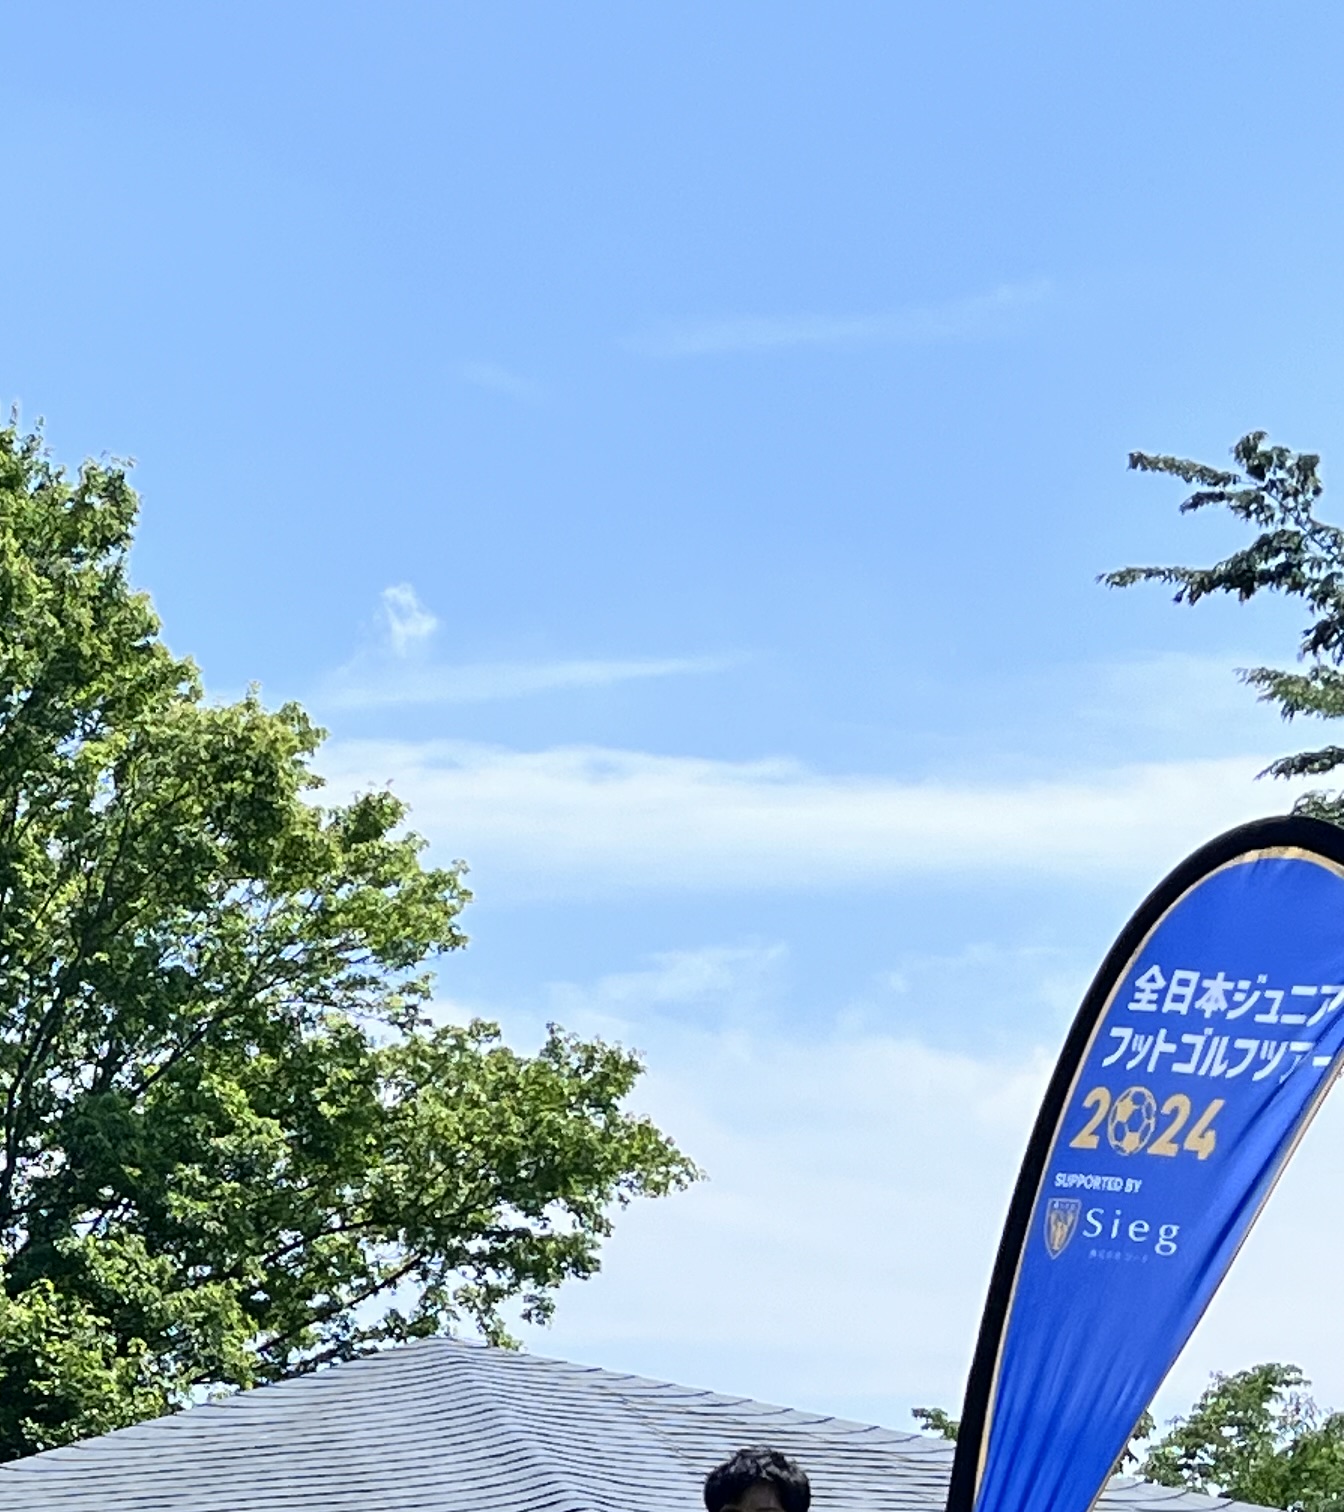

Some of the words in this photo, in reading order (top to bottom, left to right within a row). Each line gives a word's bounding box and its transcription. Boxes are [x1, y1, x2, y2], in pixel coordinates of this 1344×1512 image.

[1127, 965, 1344, 1027] 全日本ジュニア
[1069, 1086, 1225, 1160] 2024
[1054, 1172, 1123, 1192] SUPPORTED
[1124, 1178, 1143, 1193] BY
[1082, 1208, 1180, 1256] Sieg
